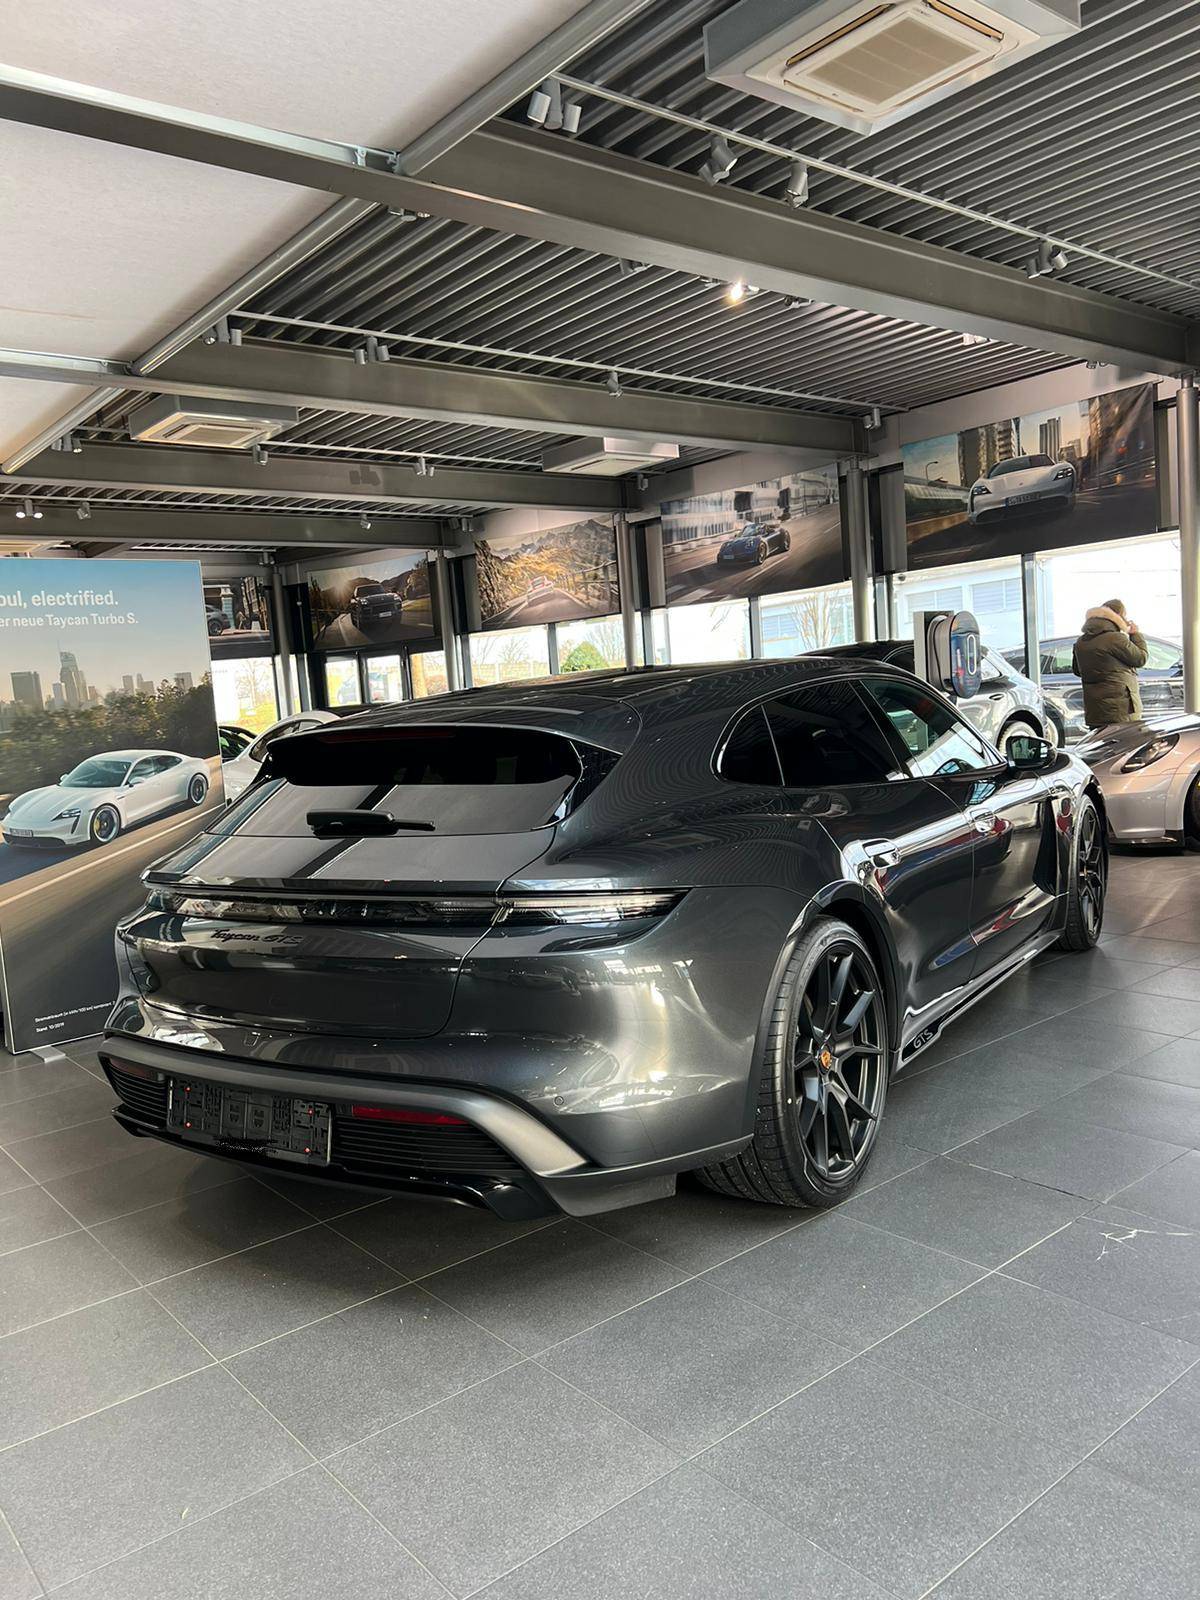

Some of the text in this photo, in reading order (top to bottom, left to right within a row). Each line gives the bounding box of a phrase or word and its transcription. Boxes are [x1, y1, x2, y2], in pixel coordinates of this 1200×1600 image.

[31, 590, 119, 607] electrified.
[13, 616, 44, 627] neue
[45, 614, 89, 629] Taycan
[90, 613, 125, 625] Turbo
[127, 612, 139, 624] S.
[211, 928, 303, 945] Taycan GTS
[913, 1028, 934, 1049] GTS
